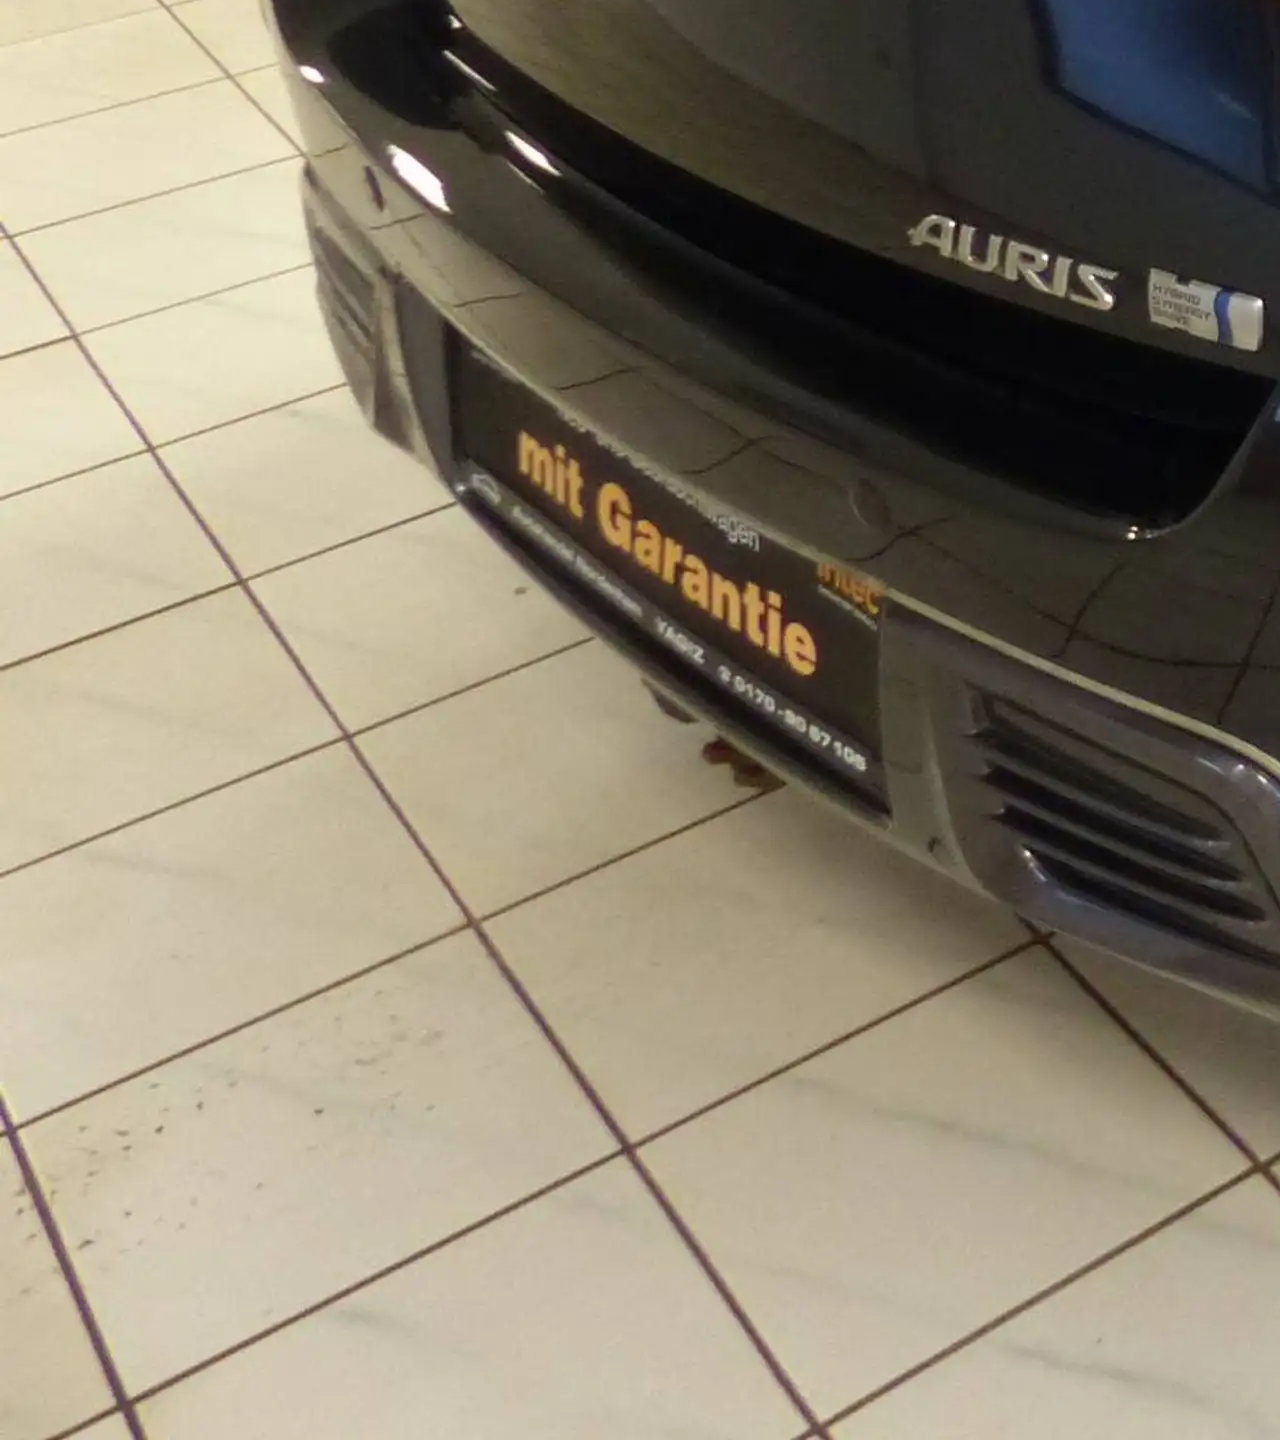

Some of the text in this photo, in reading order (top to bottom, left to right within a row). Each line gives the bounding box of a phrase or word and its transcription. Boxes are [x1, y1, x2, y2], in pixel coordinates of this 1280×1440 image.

[907, 214, 1118, 310] AURIS
[518, 430, 584, 519] mit
[597, 482, 818, 676] Garantie
